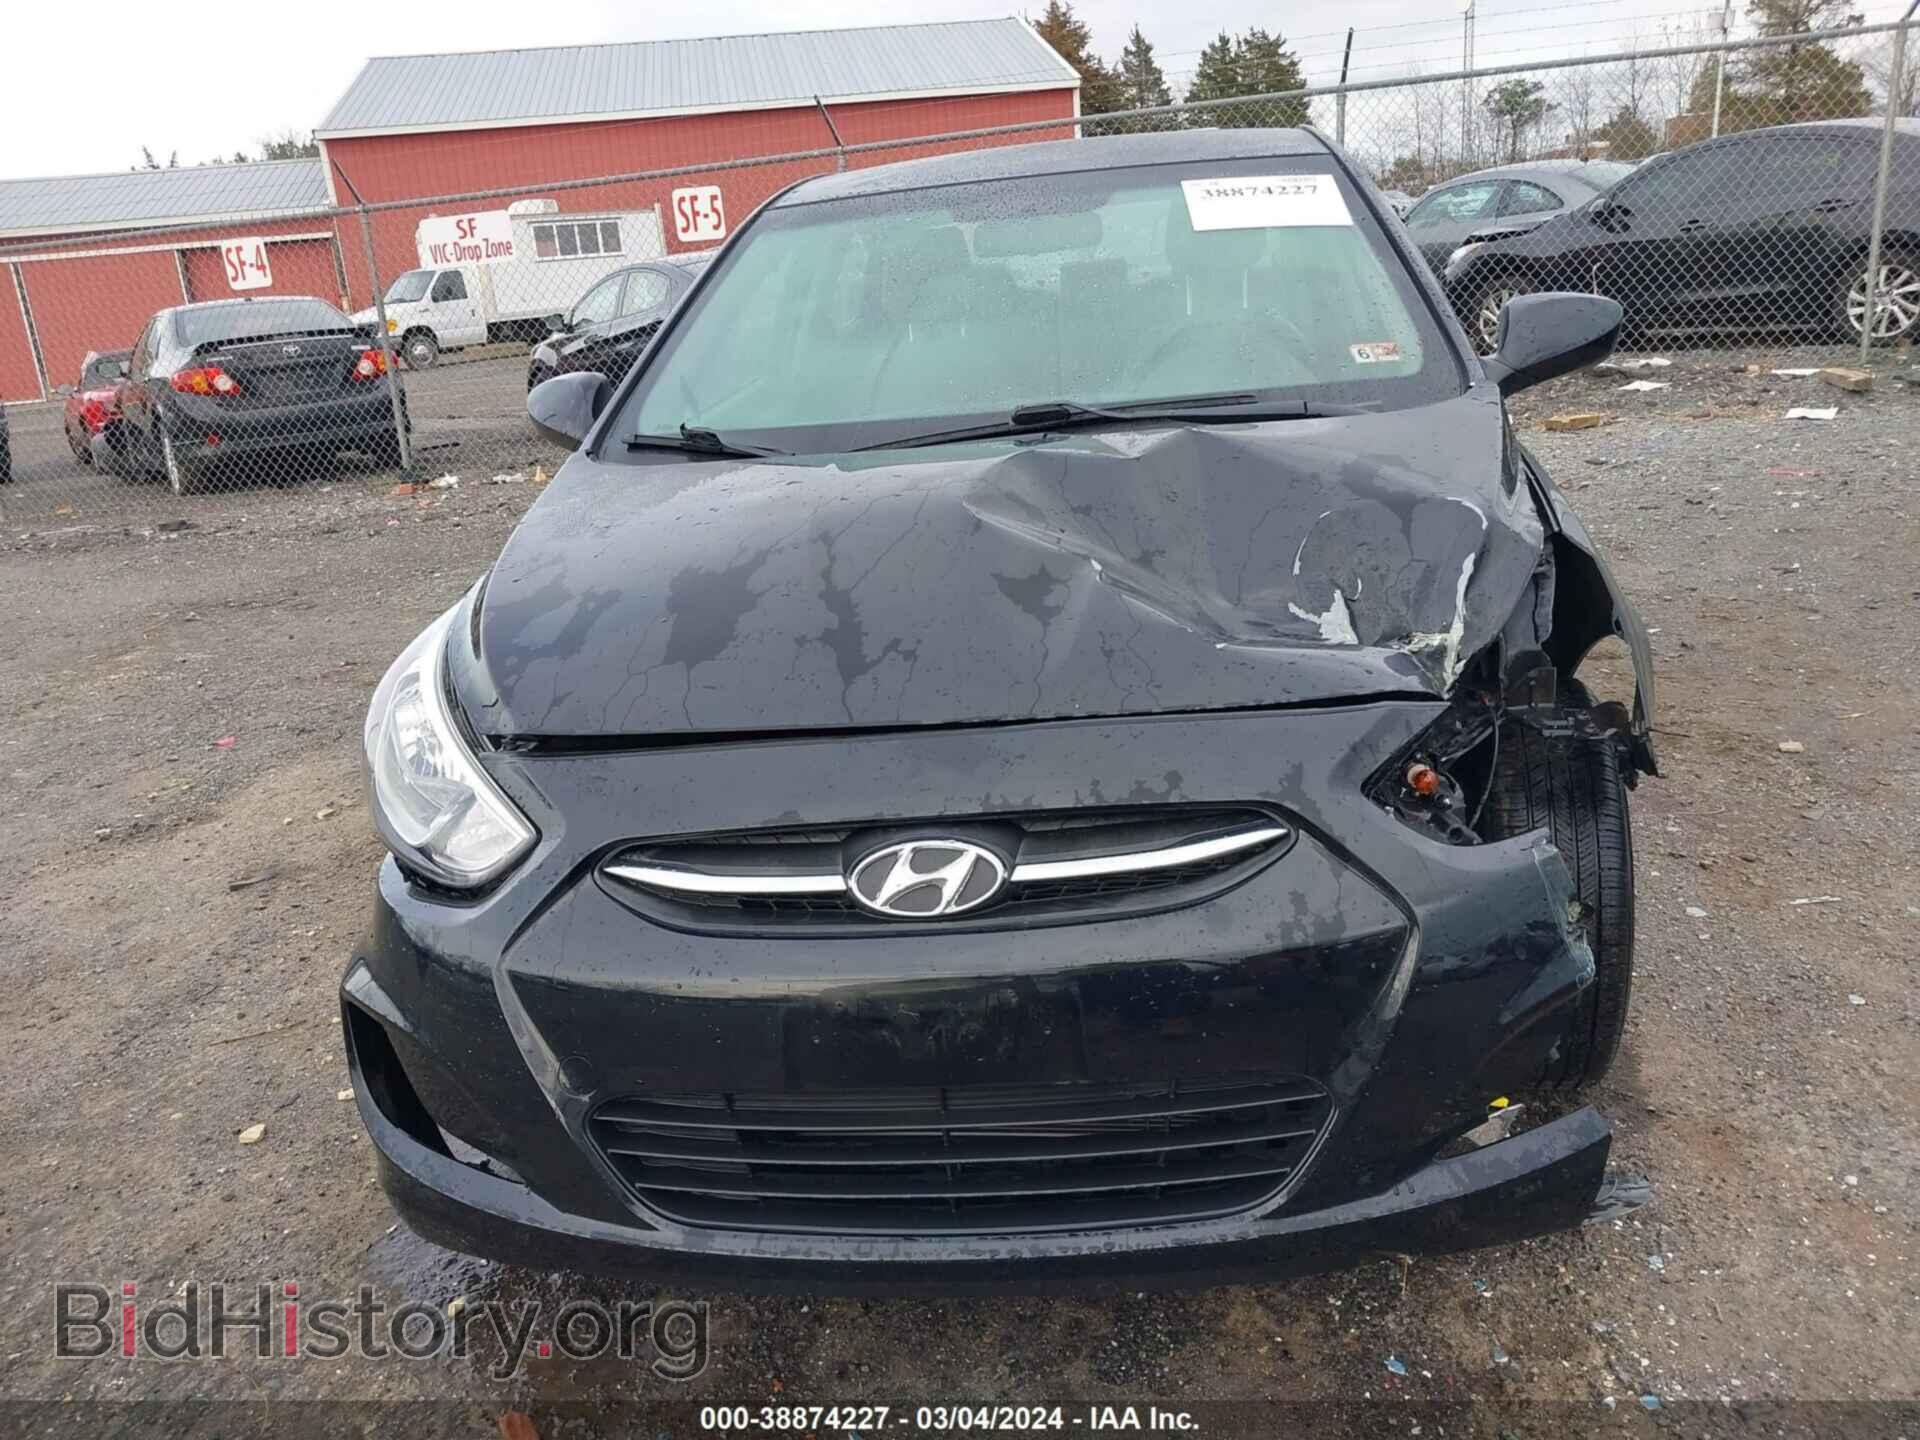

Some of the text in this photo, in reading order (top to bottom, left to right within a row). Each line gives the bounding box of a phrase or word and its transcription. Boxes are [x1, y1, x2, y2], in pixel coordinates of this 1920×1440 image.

[677, 194, 722, 234] SF-5
[455, 217, 478, 240] SF
[225, 244, 267, 282] SF-4
[429, 238, 513, 265] VIC-Drop Zone
[1357, 349, 1370, 360] 6
